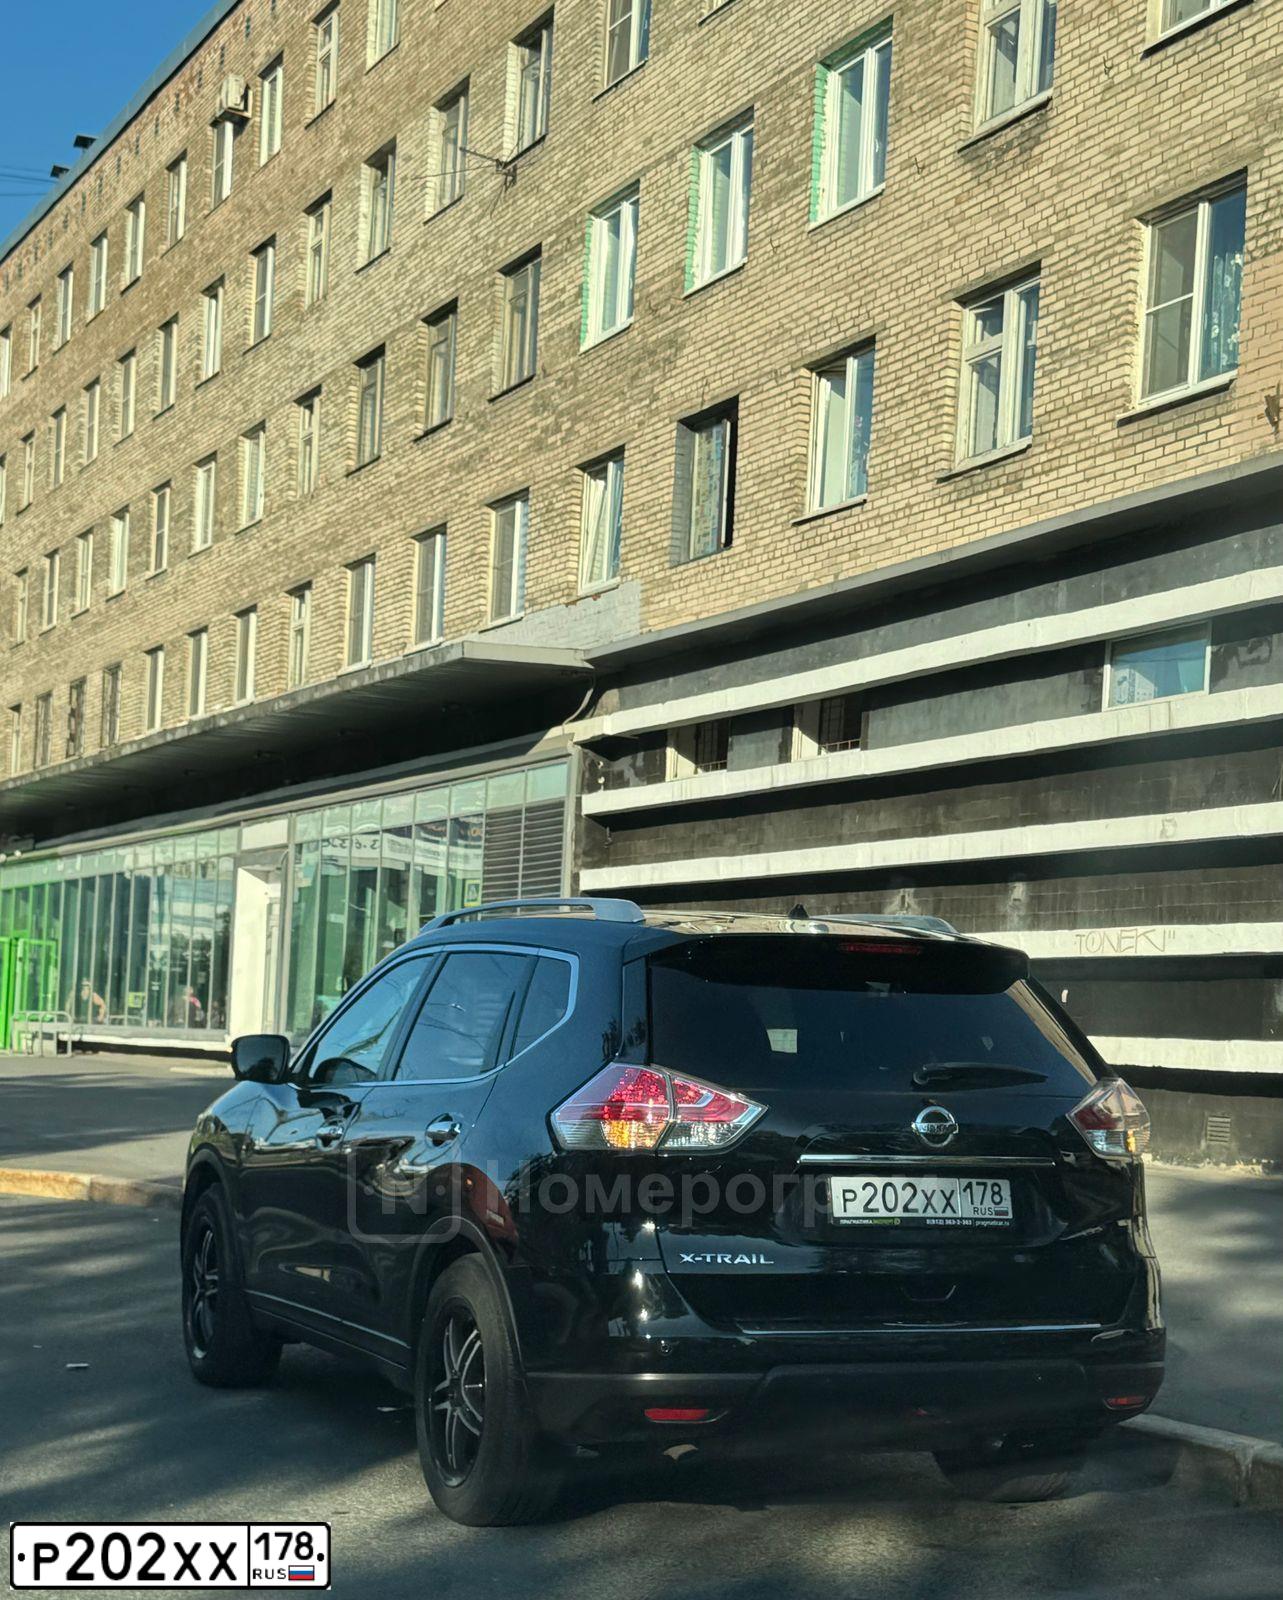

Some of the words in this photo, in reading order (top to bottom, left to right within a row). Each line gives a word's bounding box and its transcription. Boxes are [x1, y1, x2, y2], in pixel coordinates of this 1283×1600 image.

[962, 1181, 1003, 1206] 178
[973, 1206, 993, 1216] RUS
[679, 1253, 775, 1265] X-TRAIL
